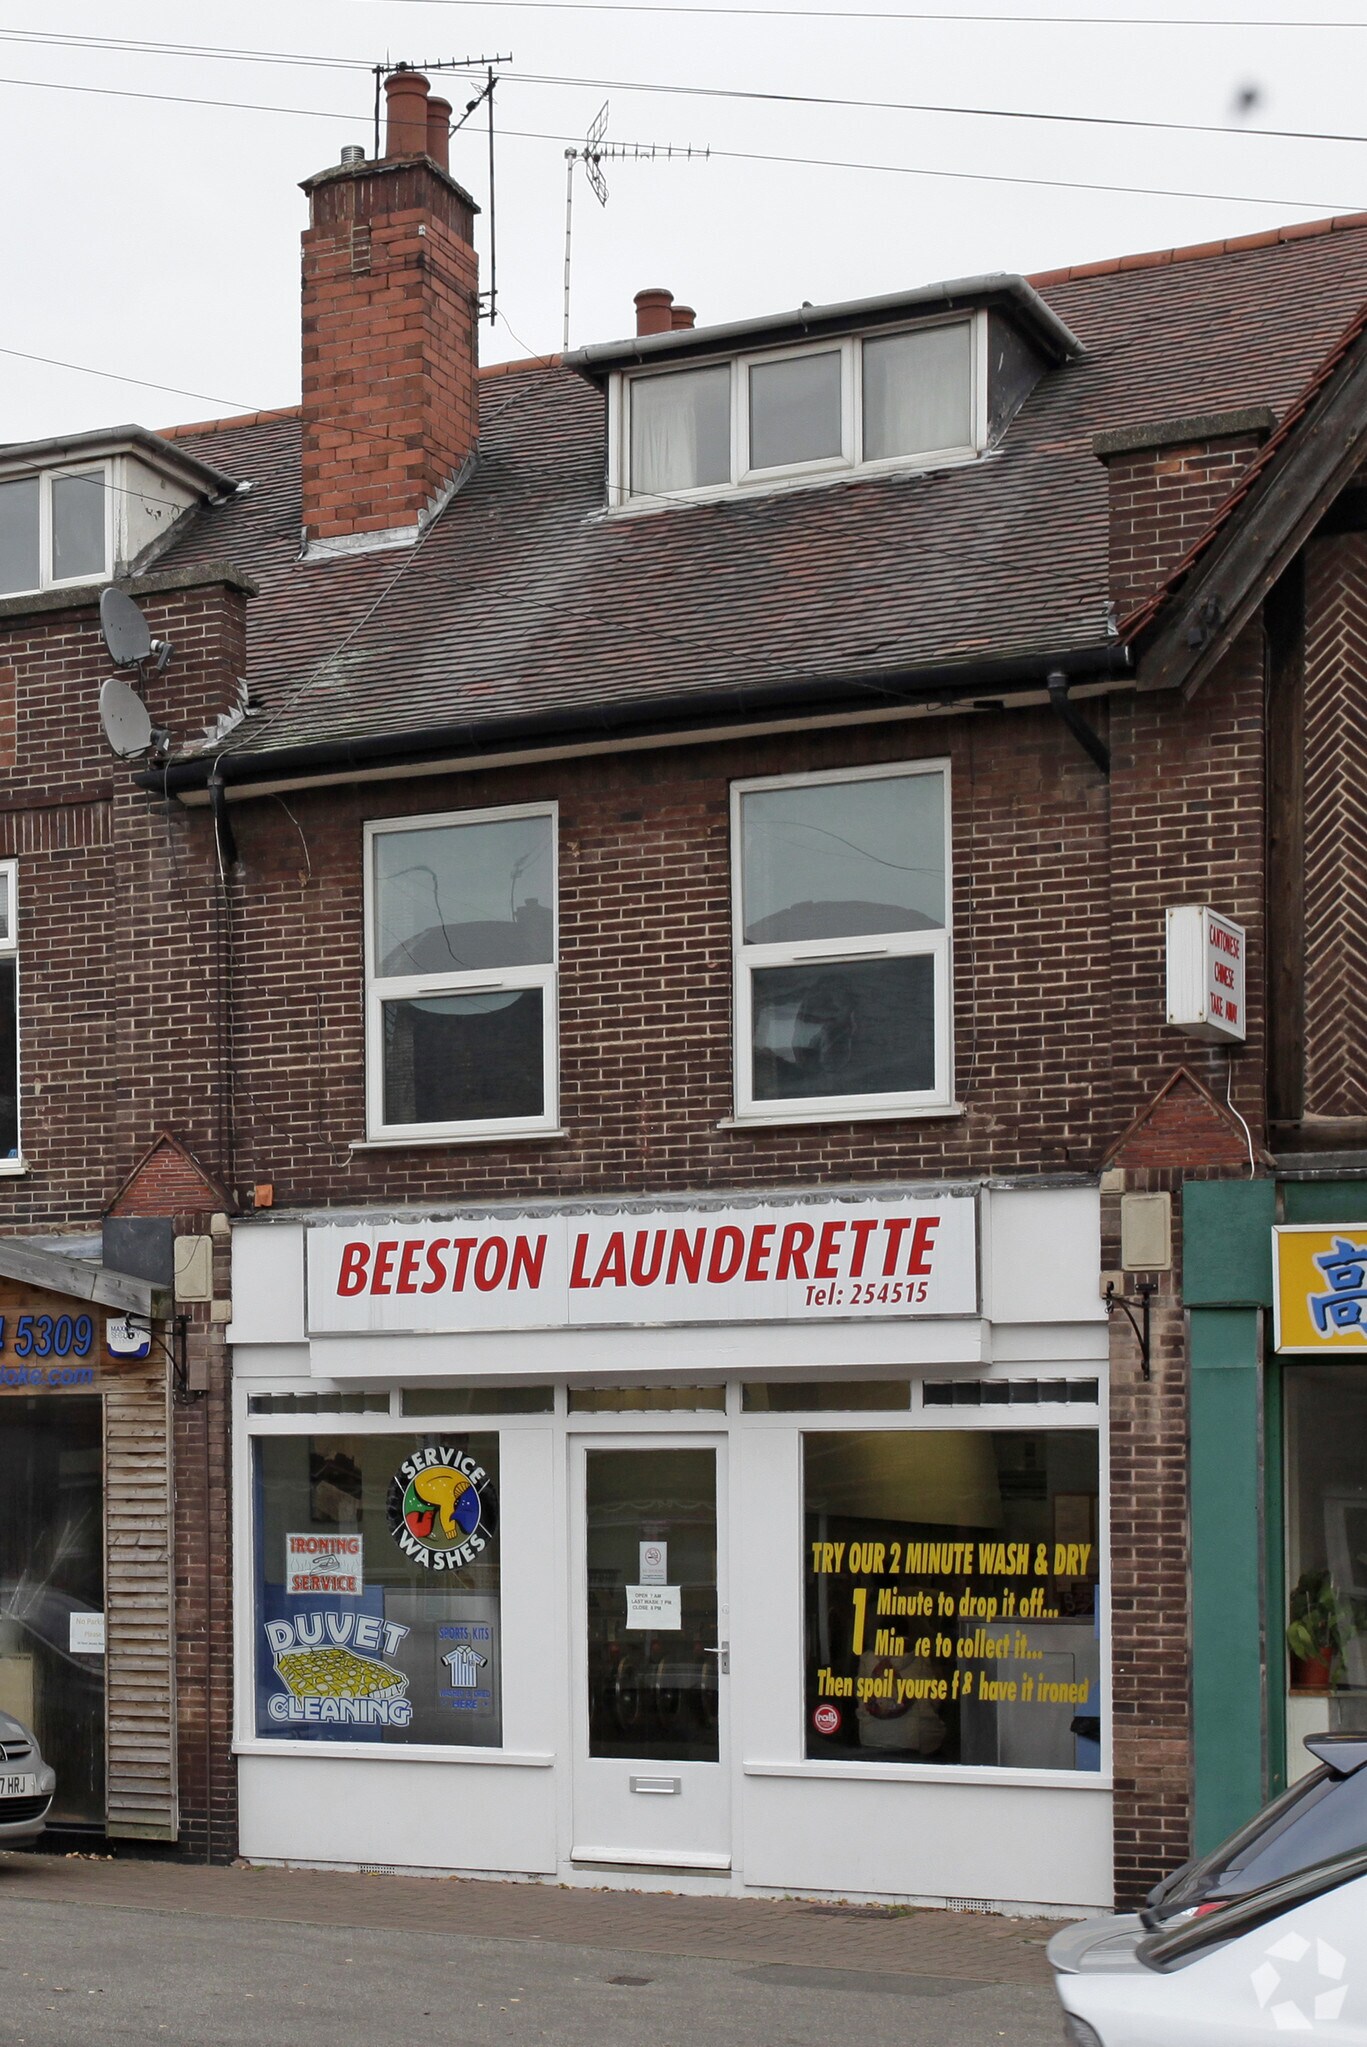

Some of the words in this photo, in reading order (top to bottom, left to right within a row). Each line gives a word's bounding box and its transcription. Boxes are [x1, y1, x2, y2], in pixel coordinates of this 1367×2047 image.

[336, 1234, 548, 1297] BEESTON
[569, 1216, 941, 1289] LAUNDERETTE
[805, 1282, 844, 1306] Tel:
[850, 1281, 928, 1304] 254515
[14, 1313, 93, 1357] 5309
[401, 1446, 486, 1484] SERVICE
[290, 1536, 359, 1554] IRONING
[397, 1530, 486, 1571] WASHES
[812, 1542, 845, 1574] TRY
[849, 1542, 886, 1574] OUR
[888, 1542, 900, 1574] 2
[904, 1543, 974, 1575] MINUTE
[978, 1543, 1030, 1575] WASH
[1034, 1543, 1048, 1575] &
[1053, 1543, 1091, 1575] DRY
[292, 1575, 357, 1592] SERVICE
[852, 1588, 866, 1655] 1
[876, 1587, 933, 1616] Minute
[937, 1591, 954, 1616] to
[959, 1588, 998, 1622] drop
[1002, 1588, 1014, 1617] it
[264, 1612, 410, 1657] DUVET
[439, 1627, 468, 1640] SPORTS
[472, 1627, 490, 1640] KITS
[936, 1632, 952, 1658] to
[956, 1628, 1010, 1659] collect
[817, 1667, 852, 1697] Then
[857, 1669, 893, 1703] spoil
[979, 1671, 1018, 1701] have
[1022, 1672, 1034, 1702] it
[1037, 1672, 1090, 1703] ironed
[268, 1694, 413, 1727] CLEANING
[7, 1776, 26, 1794] HRJ
